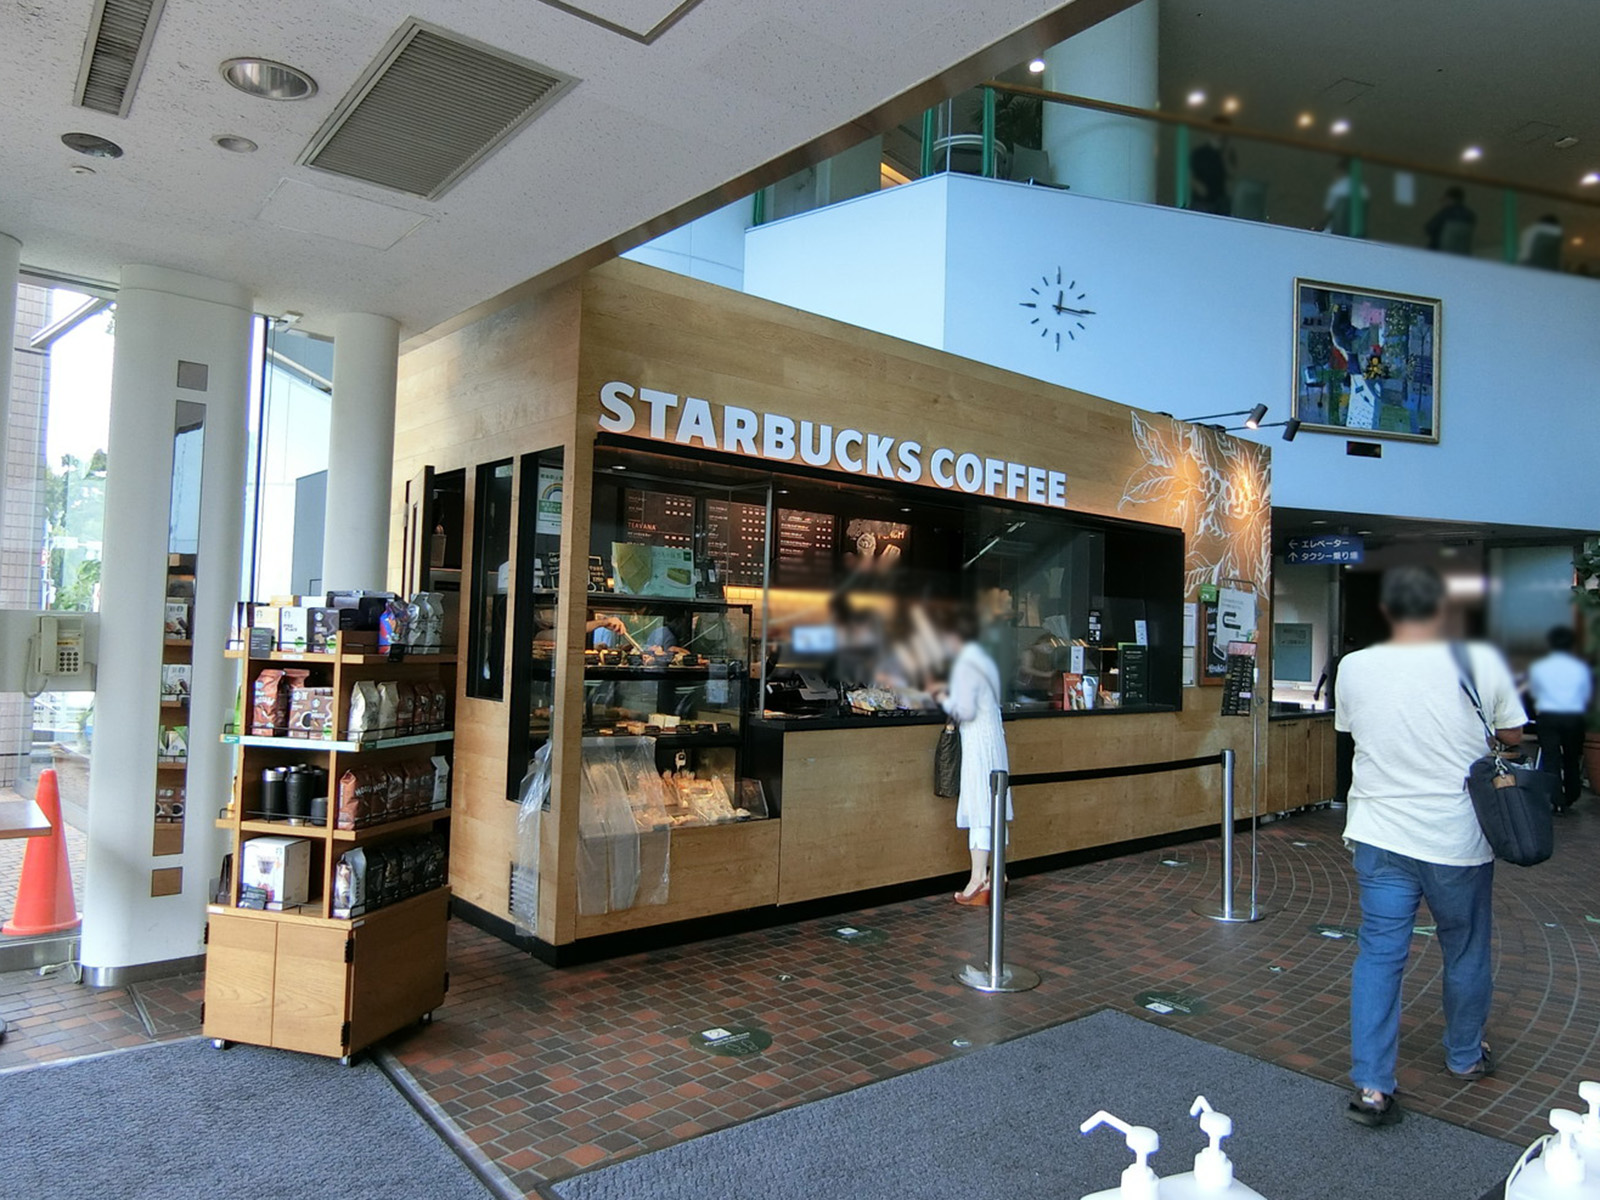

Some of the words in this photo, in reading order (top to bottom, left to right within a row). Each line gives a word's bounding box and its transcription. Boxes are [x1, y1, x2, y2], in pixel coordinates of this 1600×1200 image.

[598, 380, 923, 483] STARBUCKS
[930, 447, 1067, 507] COFFEE
[1301, 539, 1350, 549] エレベーター
